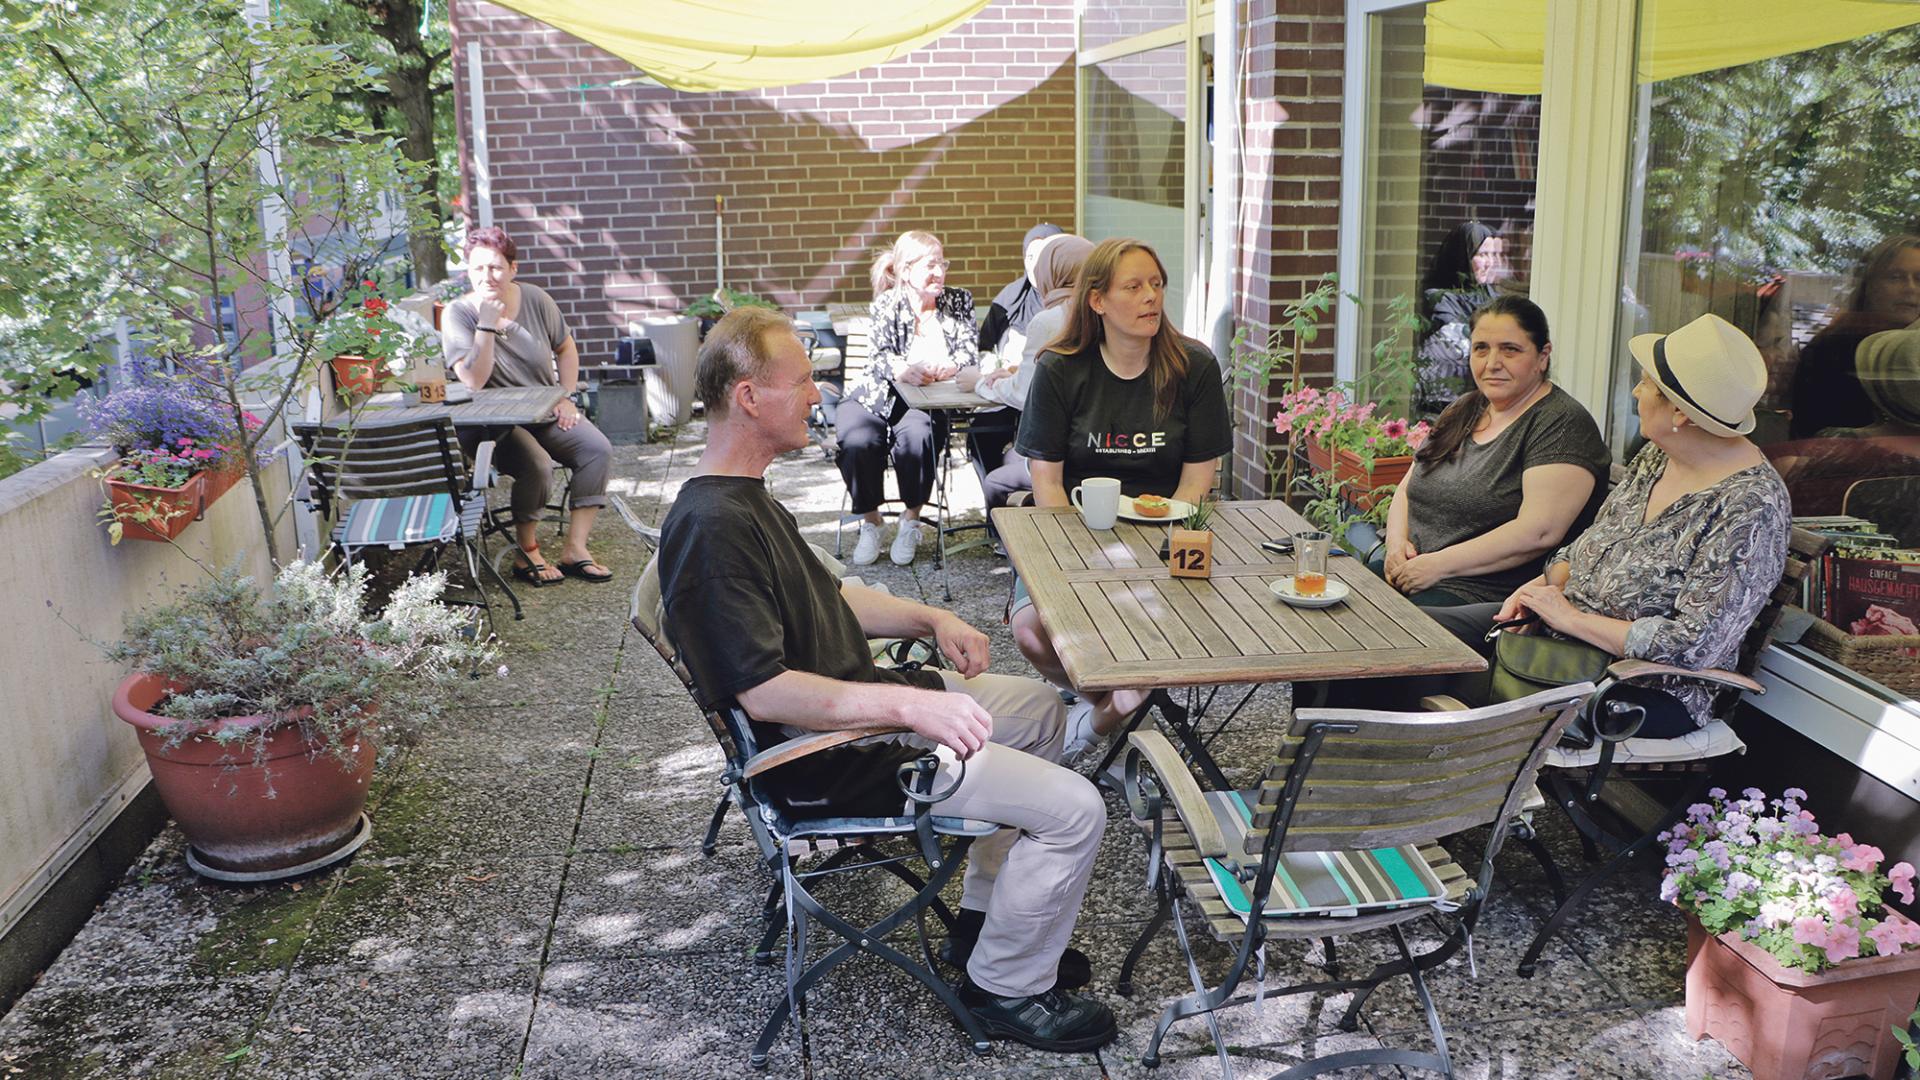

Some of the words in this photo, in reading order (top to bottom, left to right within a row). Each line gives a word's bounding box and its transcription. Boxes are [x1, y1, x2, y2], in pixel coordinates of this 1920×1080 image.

[419, 386, 431, 398] 13
[1087, 432, 1166, 448] NICCE
[1173, 549, 1205, 570] 12
[1869, 568, 1898, 581] EINFACH
[1848, 576, 1920, 600] HAUSGEMACHT
